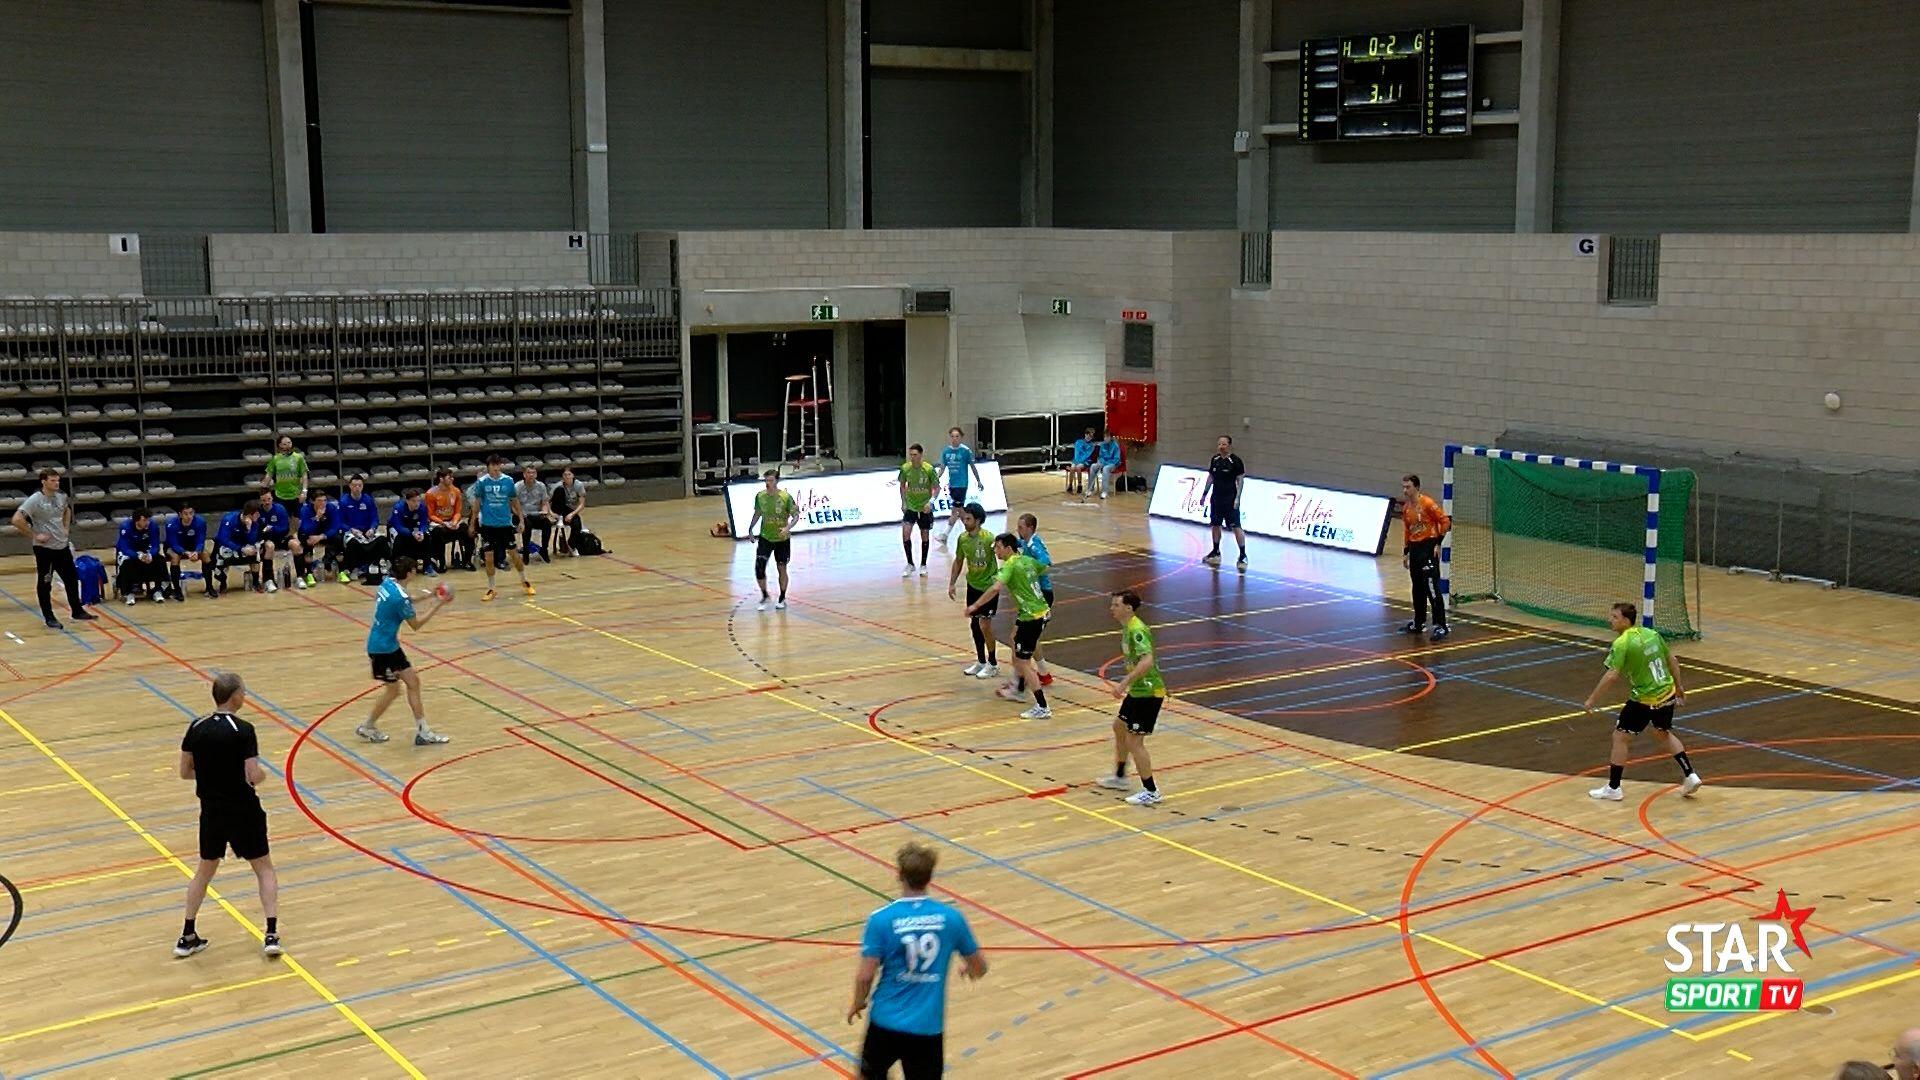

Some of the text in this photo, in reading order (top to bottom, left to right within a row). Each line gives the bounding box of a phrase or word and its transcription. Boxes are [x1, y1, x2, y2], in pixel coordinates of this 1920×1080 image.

[1343, 33, 1423, 57] H 0-2 G
[121, 236, 128, 252] I
[569, 235, 582, 248] H
[1579, 239, 1594, 254] G
[901, 932, 941, 974] 19
